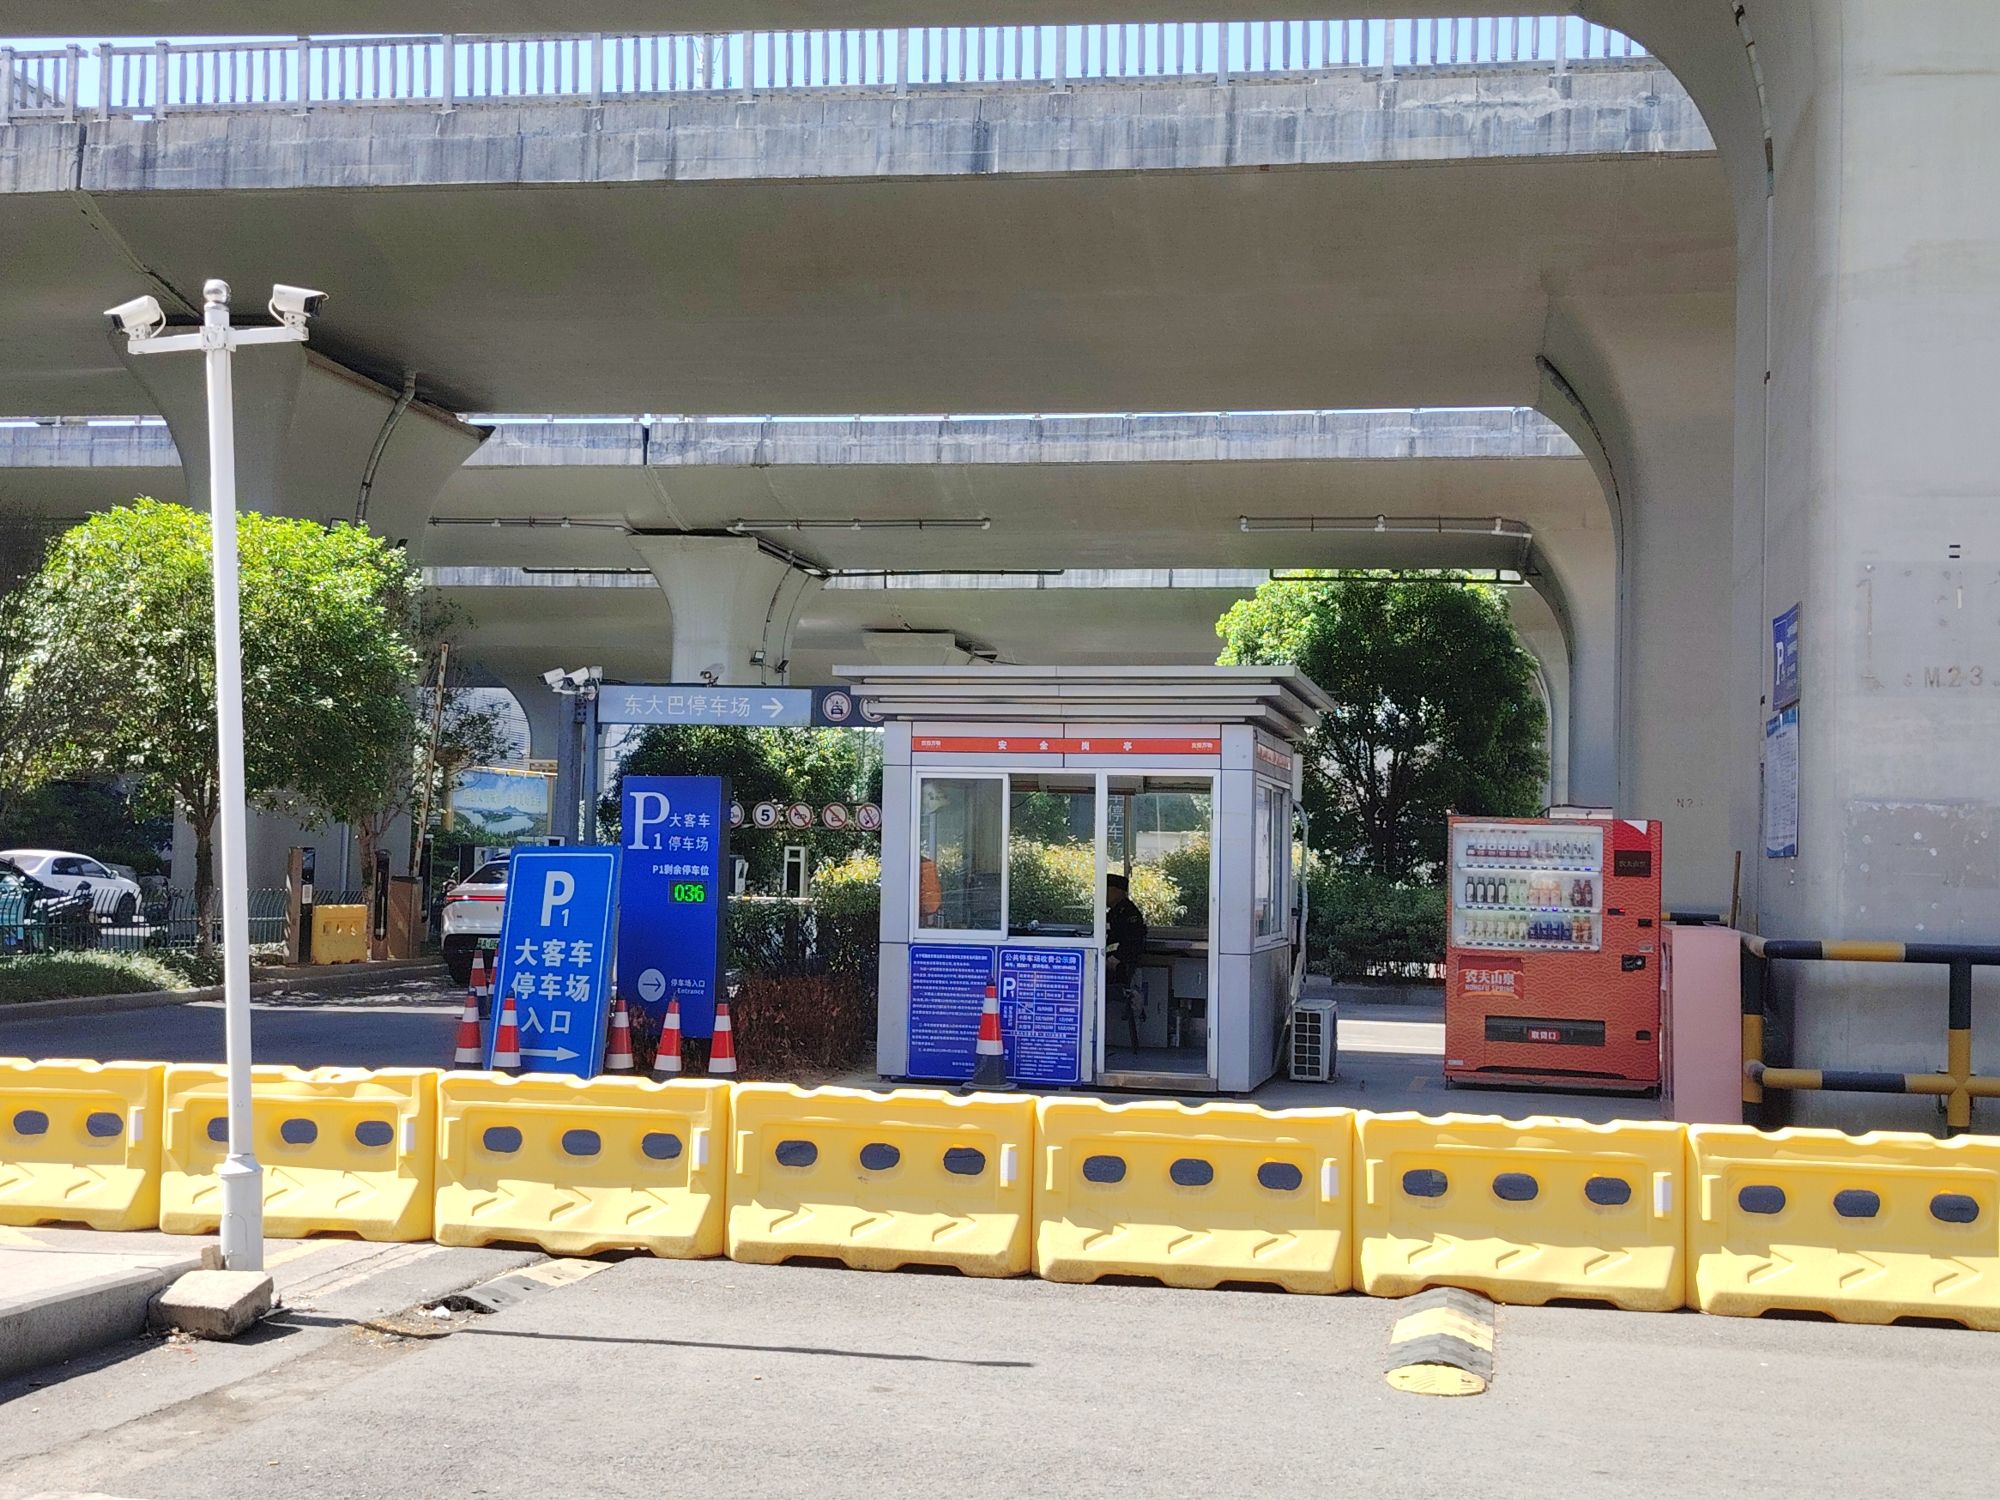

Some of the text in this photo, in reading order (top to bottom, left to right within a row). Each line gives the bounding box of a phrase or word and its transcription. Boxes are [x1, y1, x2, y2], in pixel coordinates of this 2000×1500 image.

[624, 695, 750, 717] 东大巴停车场
[669, 813, 711, 828] 大客车
[760, 809, 770, 822] 5
[668, 836, 709, 852] 停车场
[652, 864, 709, 876] P1剩余停车位
[674, 883, 705, 903] 036
[514, 938, 593, 968] 大客车
[670, 979, 705, 988] 停车场入口
[1465, 970, 1515, 985] 农夫山泉
[511, 972, 591, 1002] 停车场
[520, 1007, 571, 1034] 入口
